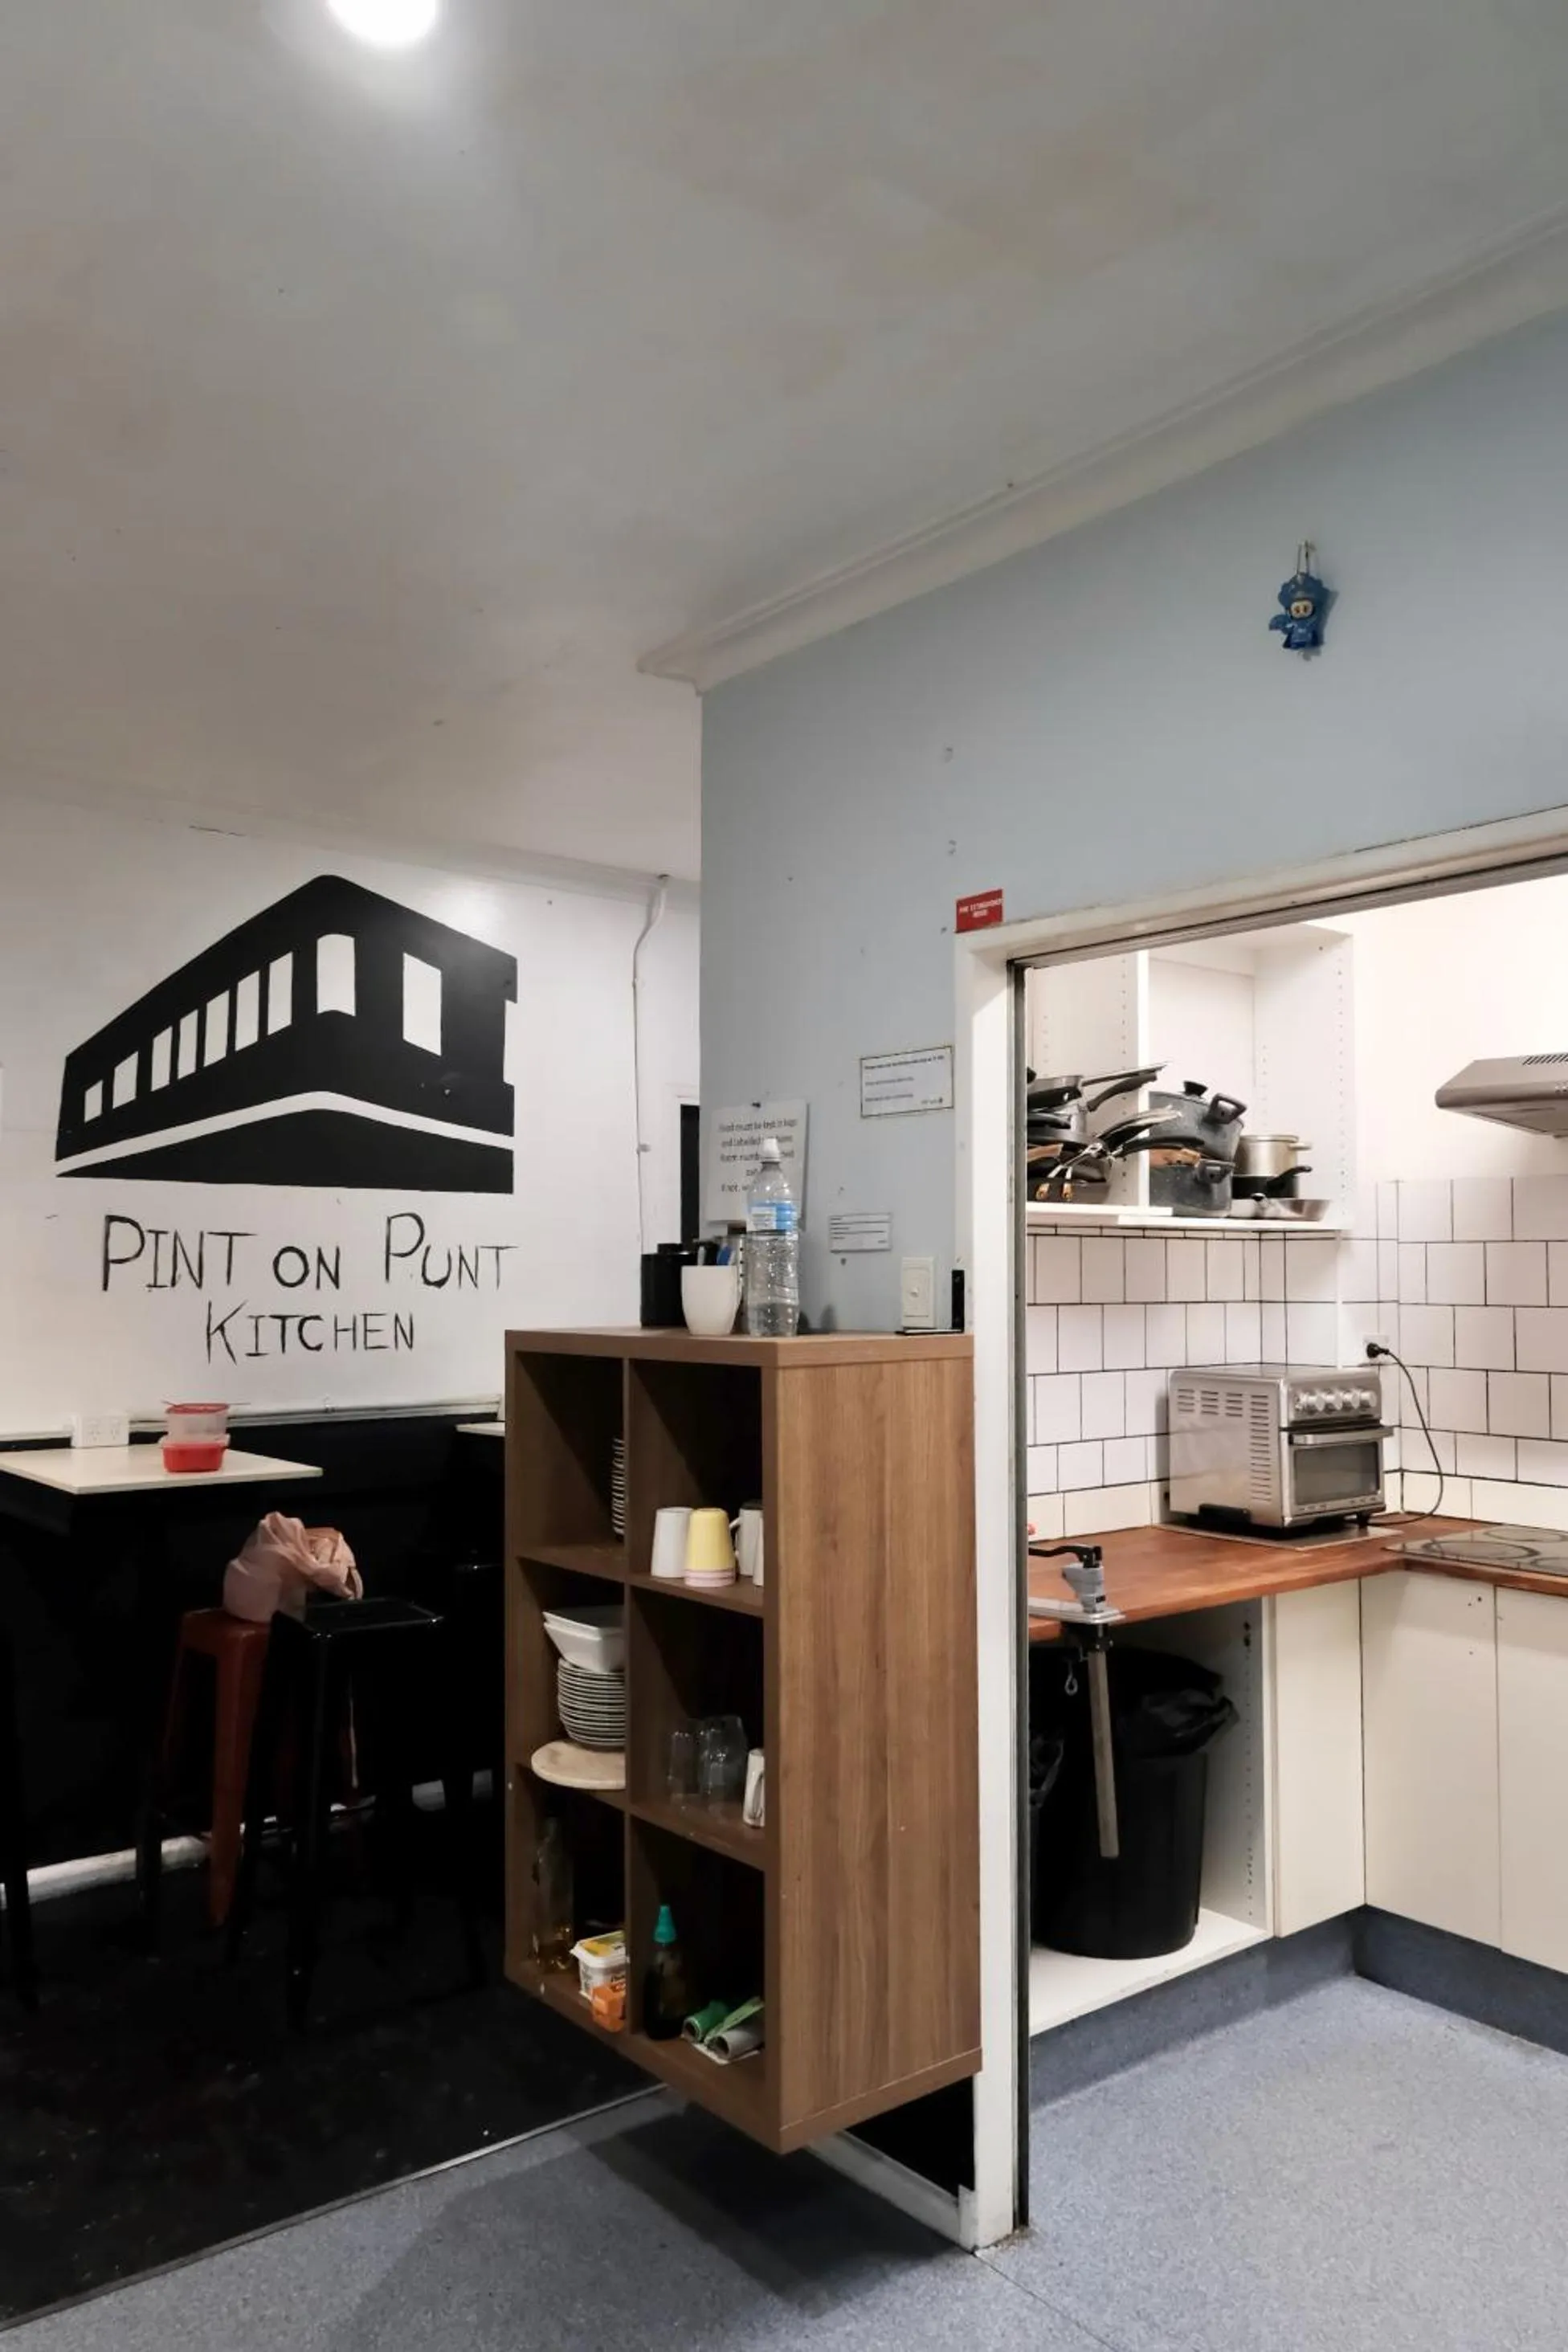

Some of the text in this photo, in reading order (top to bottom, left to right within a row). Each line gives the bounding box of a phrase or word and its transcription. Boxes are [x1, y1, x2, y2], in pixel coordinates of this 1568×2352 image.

[102, 1211, 519, 1292] PINT ON PUNT
[205, 1301, 414, 1365] KITCHEN
